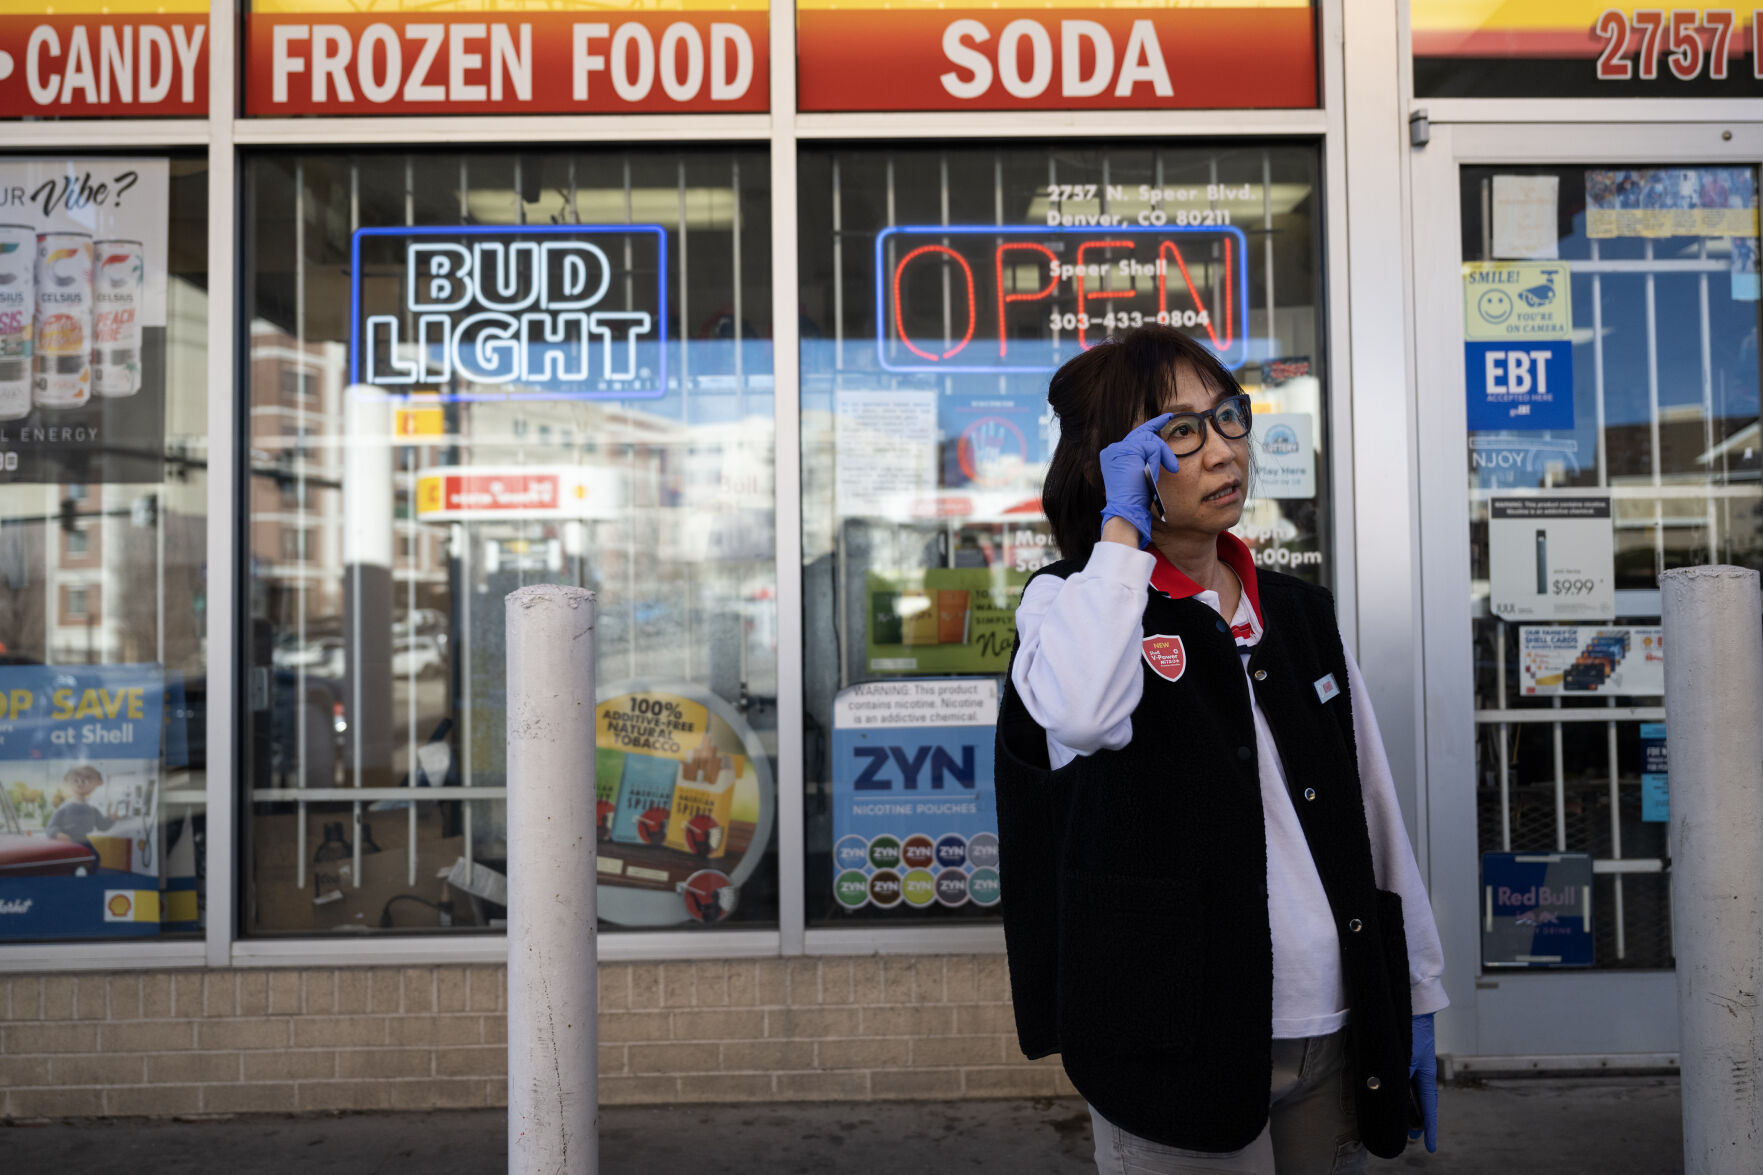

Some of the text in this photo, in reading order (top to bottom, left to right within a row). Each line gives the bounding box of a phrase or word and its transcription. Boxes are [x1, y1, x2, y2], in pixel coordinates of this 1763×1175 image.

[1595, 8, 1736, 81] 2757
[25, 24, 207, 105] CANDY
[272, 22, 755, 104] FROZEN FOOD
[939, 18, 1175, 99] SODA
[30, 170, 139, 218] Vibe?
[1047, 183, 1257, 205] 2757 N. Speer Blvd.
[1047, 209, 1231, 228] Denver, CO 80211
[407, 240, 612, 313] BUD
[1049, 258, 1168, 281] Speer Shell
[1468, 269, 1521, 285] SMILE!
[893, 237, 1233, 361] OPEN
[1049, 310, 1210, 330] 303-433-0804
[1516, 311, 1554, 323] YOU'RE
[1505, 323, 1565, 334] ON CAMERA
[366, 311, 652, 385] LIGHT
[1484, 350, 1553, 395] EBT
[20, 427, 99, 443] ENERGY
[1472, 450, 1526, 468] NJOY
[1552, 578, 1595, 596] $9.99
[1152, 641, 1169, 649] NEW
[914, 684, 936, 696] This
[938, 684, 978, 698] product
[51, 687, 145, 720] SAVE
[629, 696, 683, 720] 100%
[848, 698, 984, 711] contains nicotine. Nicotine
[602, 709, 696, 732] ADDITIVE-FREE
[853, 712, 978, 724] is an addictive chemical.
[50, 722, 135, 744] at Shell
[607, 721, 673, 742] NATURAL
[613, 732, 681, 754] TOBACCO
[853, 745, 976, 790] ZYN
[852, 803, 977, 816] NICOTINE POUCHES
[841, 848, 865, 858] ZYN
[873, 847, 898, 857] ZYN
[906, 846, 931, 857] ZYN
[939, 846, 964, 856] ZYN
[840, 882, 866, 891] ZYN
[873, 881, 899, 891] ZYN
[907, 881, 932, 890] ZYN
[940, 880, 965, 890] ZYN
[1498, 885, 1576, 907] Red Bull
